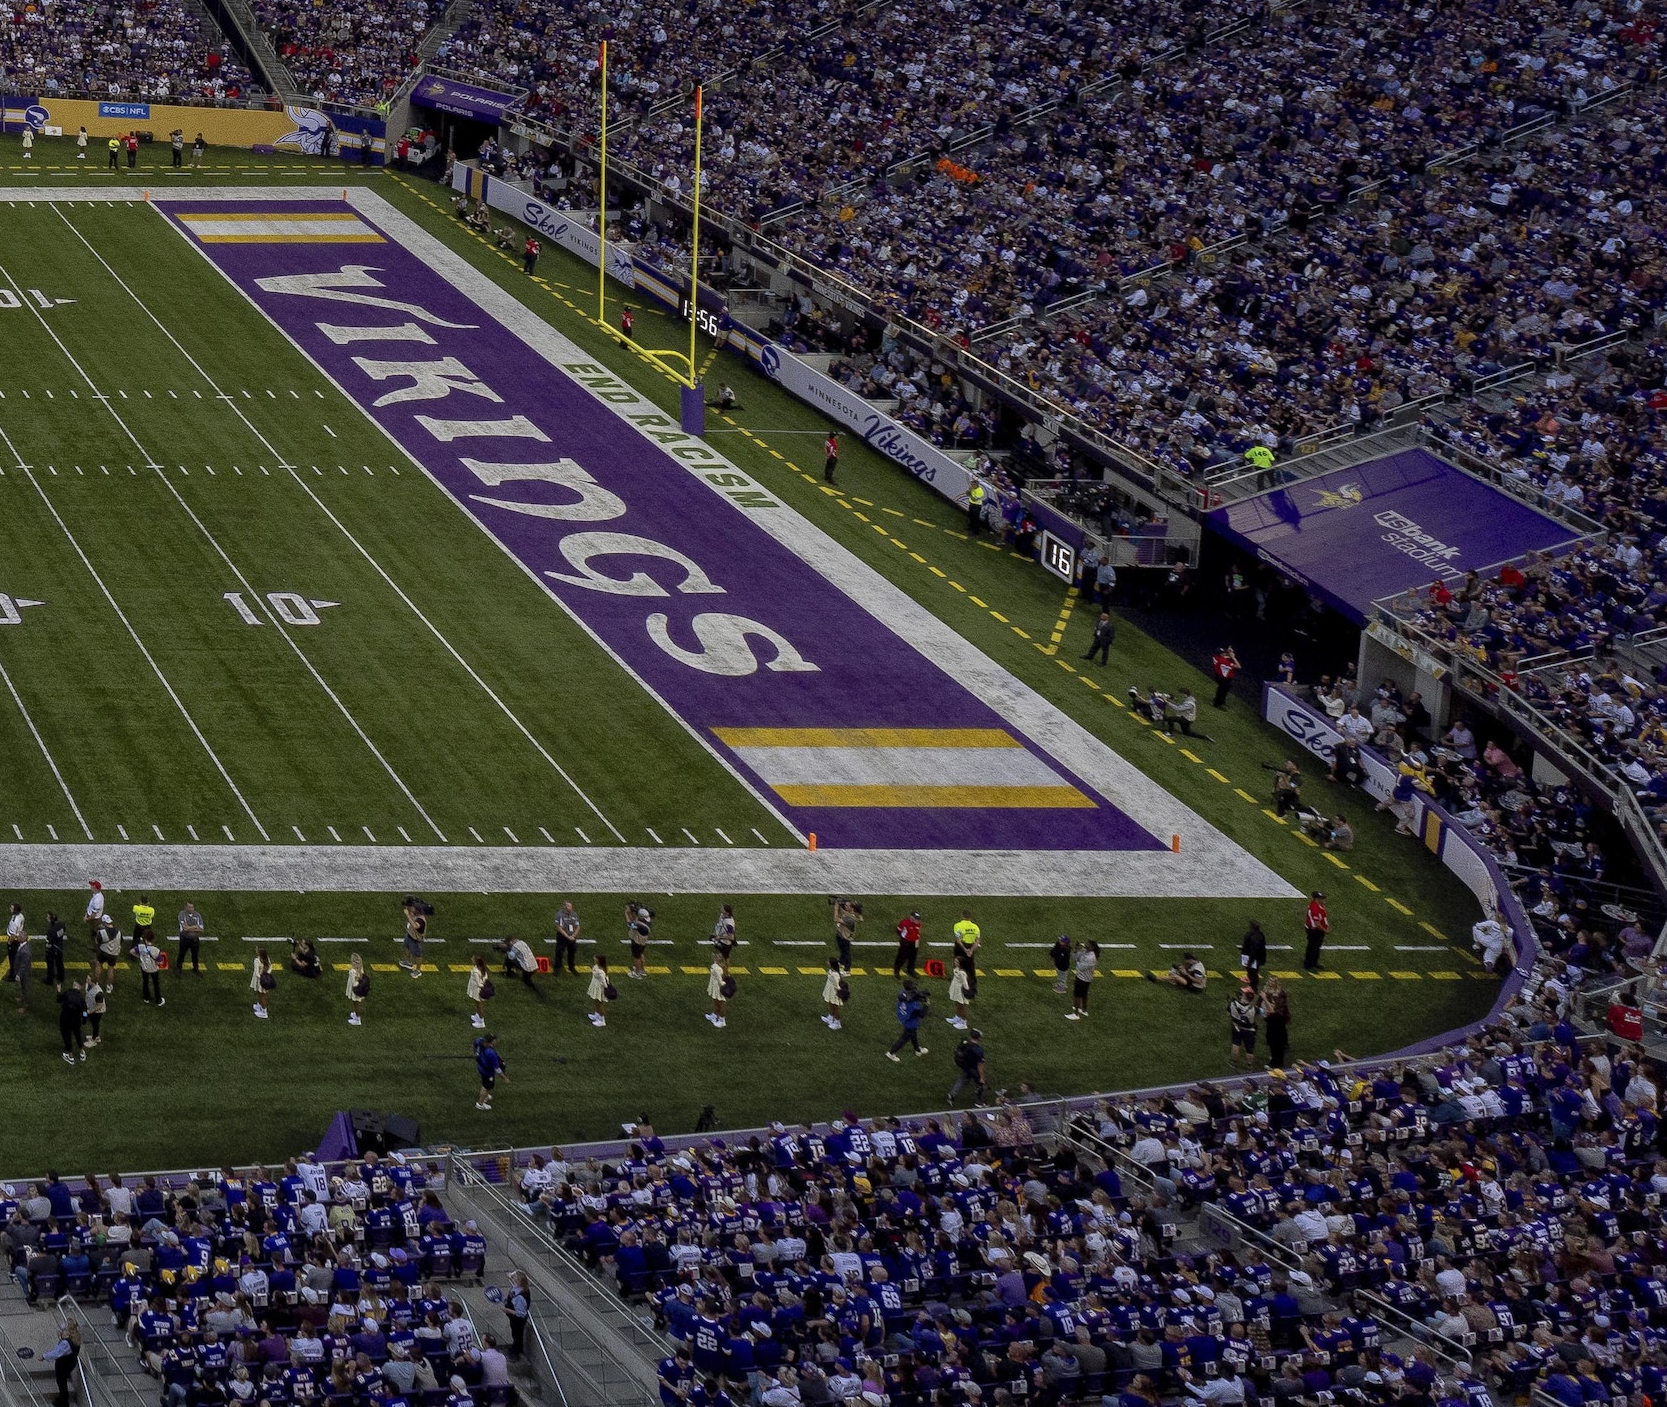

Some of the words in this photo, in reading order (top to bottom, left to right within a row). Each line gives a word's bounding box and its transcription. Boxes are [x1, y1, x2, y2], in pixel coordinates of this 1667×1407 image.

[109, 106, 126, 114] CBS
[129, 107, 147, 115] NFL
[436, 102, 474, 118] POLARIS
[450, 91, 506, 109] POLARIS
[522, 202, 568, 241] Skol
[569, 235, 599, 257] VIKINGS
[560, 364, 642, 406] END
[629, 413, 782, 509] RACISM
[807, 383, 860, 423] MINNESOTA
[863, 412, 938, 484] Vikings
[254, 264, 823, 678] VIKINGS
[1051, 543, 1070, 576] 16
[222, 591, 322, 626] 10
[1281, 708, 1336, 760] Sko
